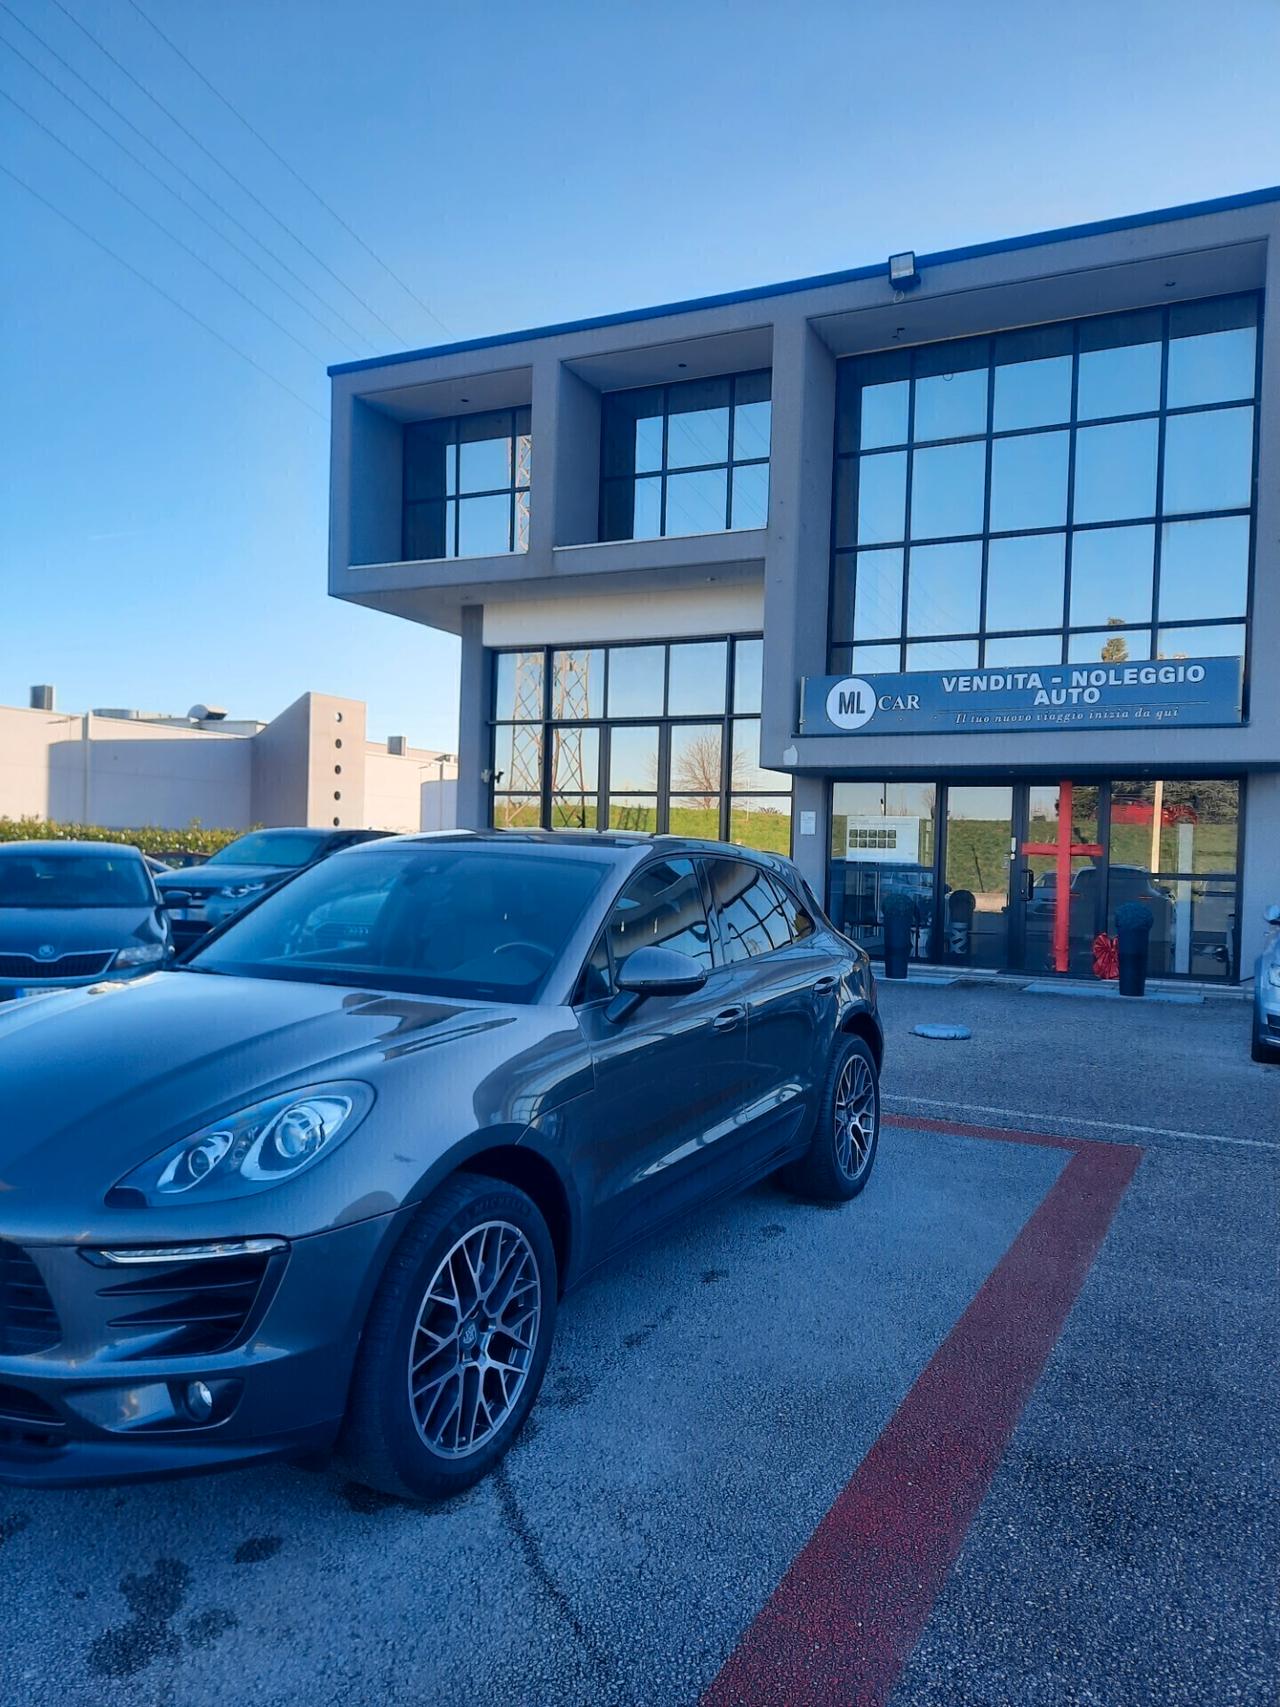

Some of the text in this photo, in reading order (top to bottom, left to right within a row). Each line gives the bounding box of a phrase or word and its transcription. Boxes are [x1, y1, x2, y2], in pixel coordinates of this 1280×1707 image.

[942, 673, 1043, 692] VENDITA
[1072, 665, 1205, 687] NOLEGGIO
[838, 691, 920, 715] ML CAR
[1033, 687, 1101, 705] AUTO
[955, 707, 1179, 724] Il tuo nuovo viaggio inizia da qui
